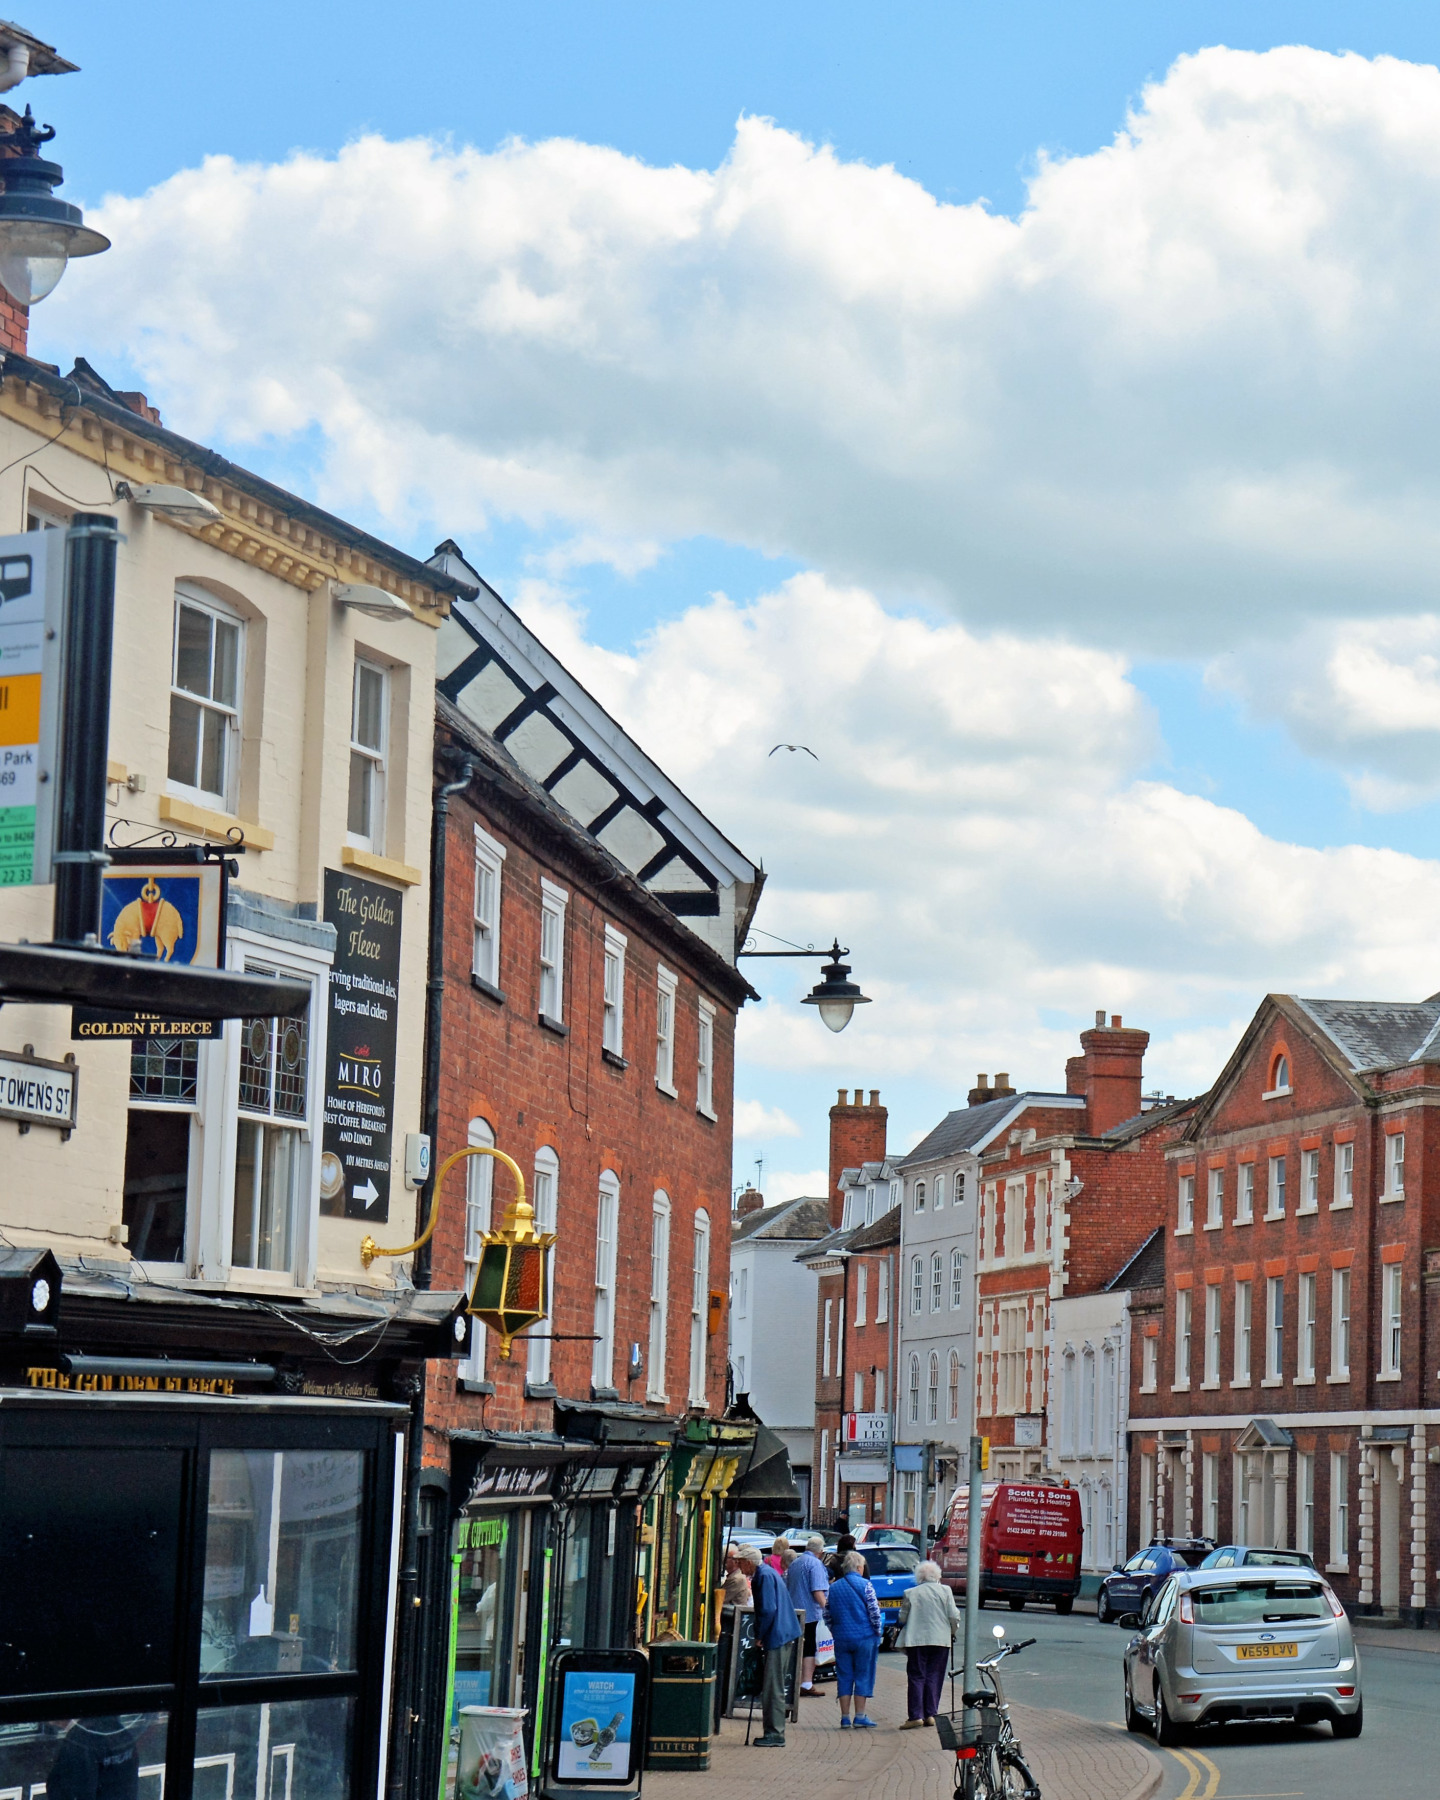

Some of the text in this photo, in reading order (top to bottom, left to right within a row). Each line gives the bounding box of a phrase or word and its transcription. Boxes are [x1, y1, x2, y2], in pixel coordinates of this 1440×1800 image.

[5, 750, 33, 765] Park
[0, 771, 15, 785] 69
[337, 888, 395, 926] The Golden
[348, 930, 381, 960] Fleece
[328, 969, 351, 991] erving
[352, 974, 385, 995] traditional
[334, 993, 388, 1021] lagers and ciders
[79, 1022, 212, 1036] GOLDEN FLEECE
[338, 1062, 381, 1088] MIRÓ
[8, 1078, 53, 1112] OWEN'S
[327, 1096, 346, 1110] HOME
[347, 1101, 355, 1112] OF
[323, 1111, 338, 1125] BEST
[361, 1117, 387, 1133] BREAKFAST
[339, 1131, 372, 1146] AND LUNCH
[345, 1154, 389, 1172] 101 METRES AHEAD
[302, 1380, 325, 1395] Welcome
[327, 1384, 333, 1395] to
[344, 1382, 363, 1398] Golden
[867, 1420, 884, 1429] TO
[864, 1431, 887, 1439] LET
[1008, 1489, 1035, 1497] Scott
[1048, 1491, 1071, 1500] Sons
[1008, 1496, 1038, 1504] Plumbing
[1046, 1498, 1071, 1507] Heating
[471, 1519, 500, 1548] CUTTING
[1241, 1645, 1270, 1657] VE59
[588, 1682, 614, 1690] WATCH
[653, 1742, 695, 1750] LITTER
